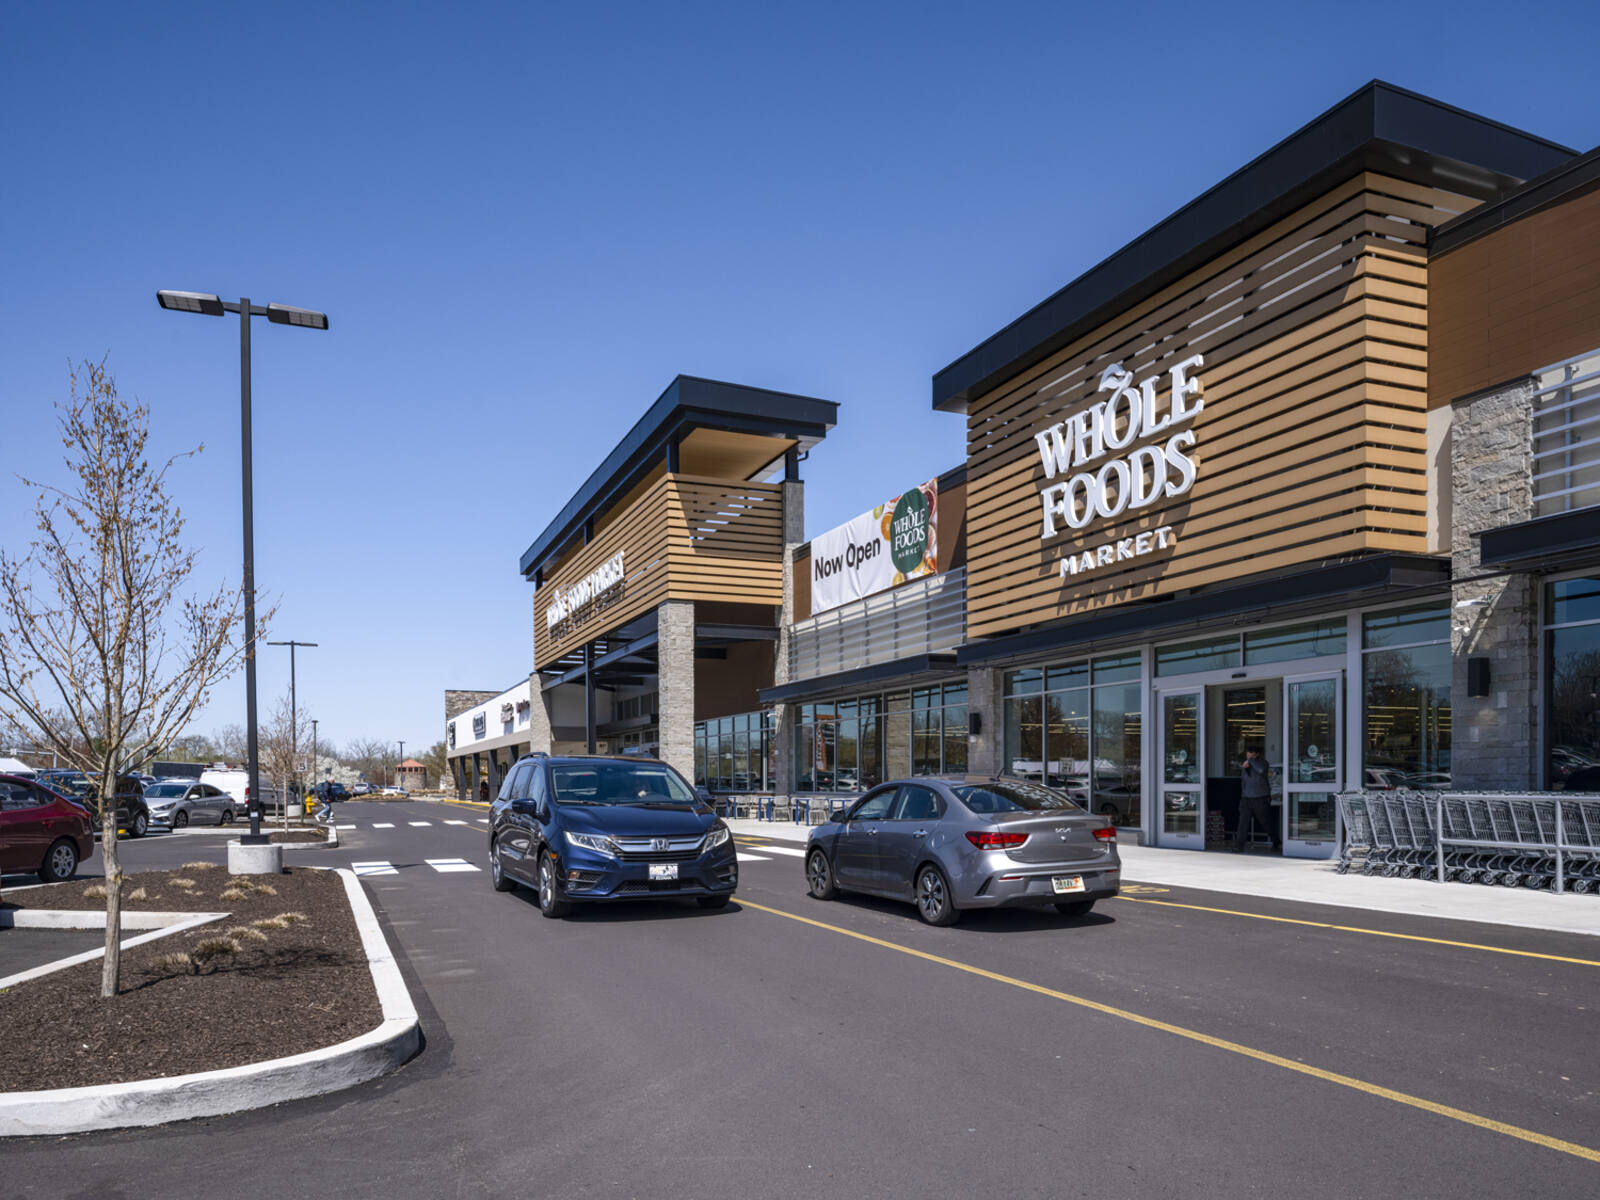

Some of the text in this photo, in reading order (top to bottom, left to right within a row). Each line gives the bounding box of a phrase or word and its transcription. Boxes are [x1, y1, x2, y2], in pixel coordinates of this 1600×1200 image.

[1034, 354, 1205, 479] WHOLE
[1040, 430, 1197, 539] FOODS
[894, 507, 925, 535] WHOLE
[895, 525, 926, 551] FOODS
[815, 537, 881, 581] Now Open
[1059, 526, 1173, 578] MARKET
